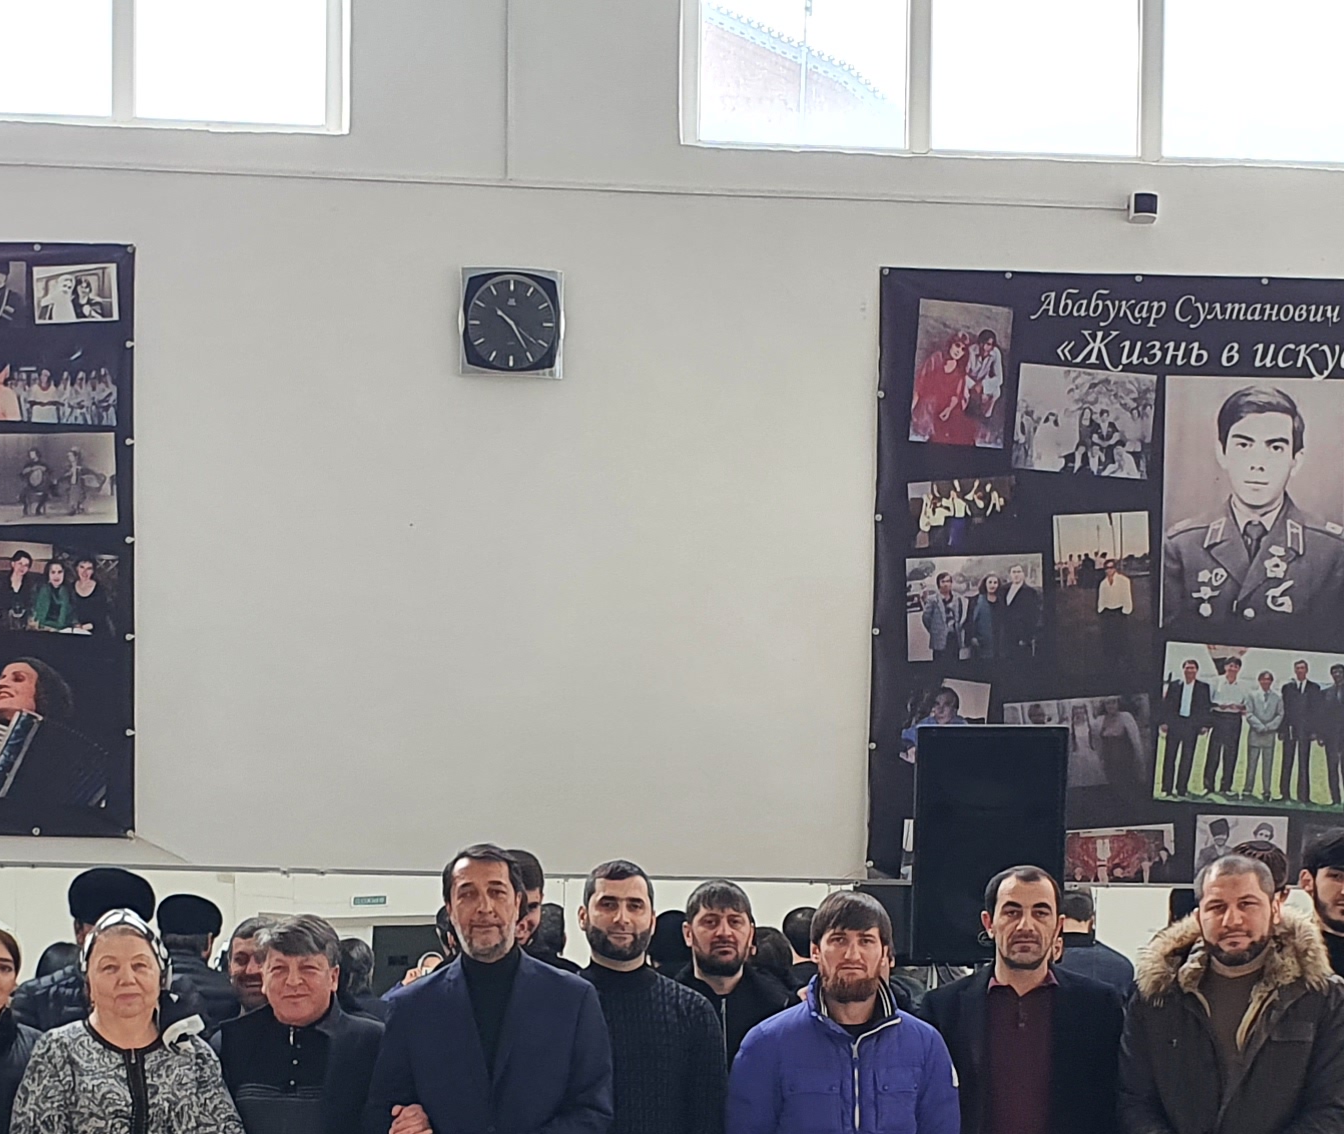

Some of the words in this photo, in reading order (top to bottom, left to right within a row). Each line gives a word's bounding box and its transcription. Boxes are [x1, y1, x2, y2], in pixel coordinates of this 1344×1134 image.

[1030, 290, 1166, 327] Абабукар
[1174, 294, 1341, 328] Султанович
[1056, 330, 1208, 371] «Жизнь
[1221, 341, 1239, 367] в
